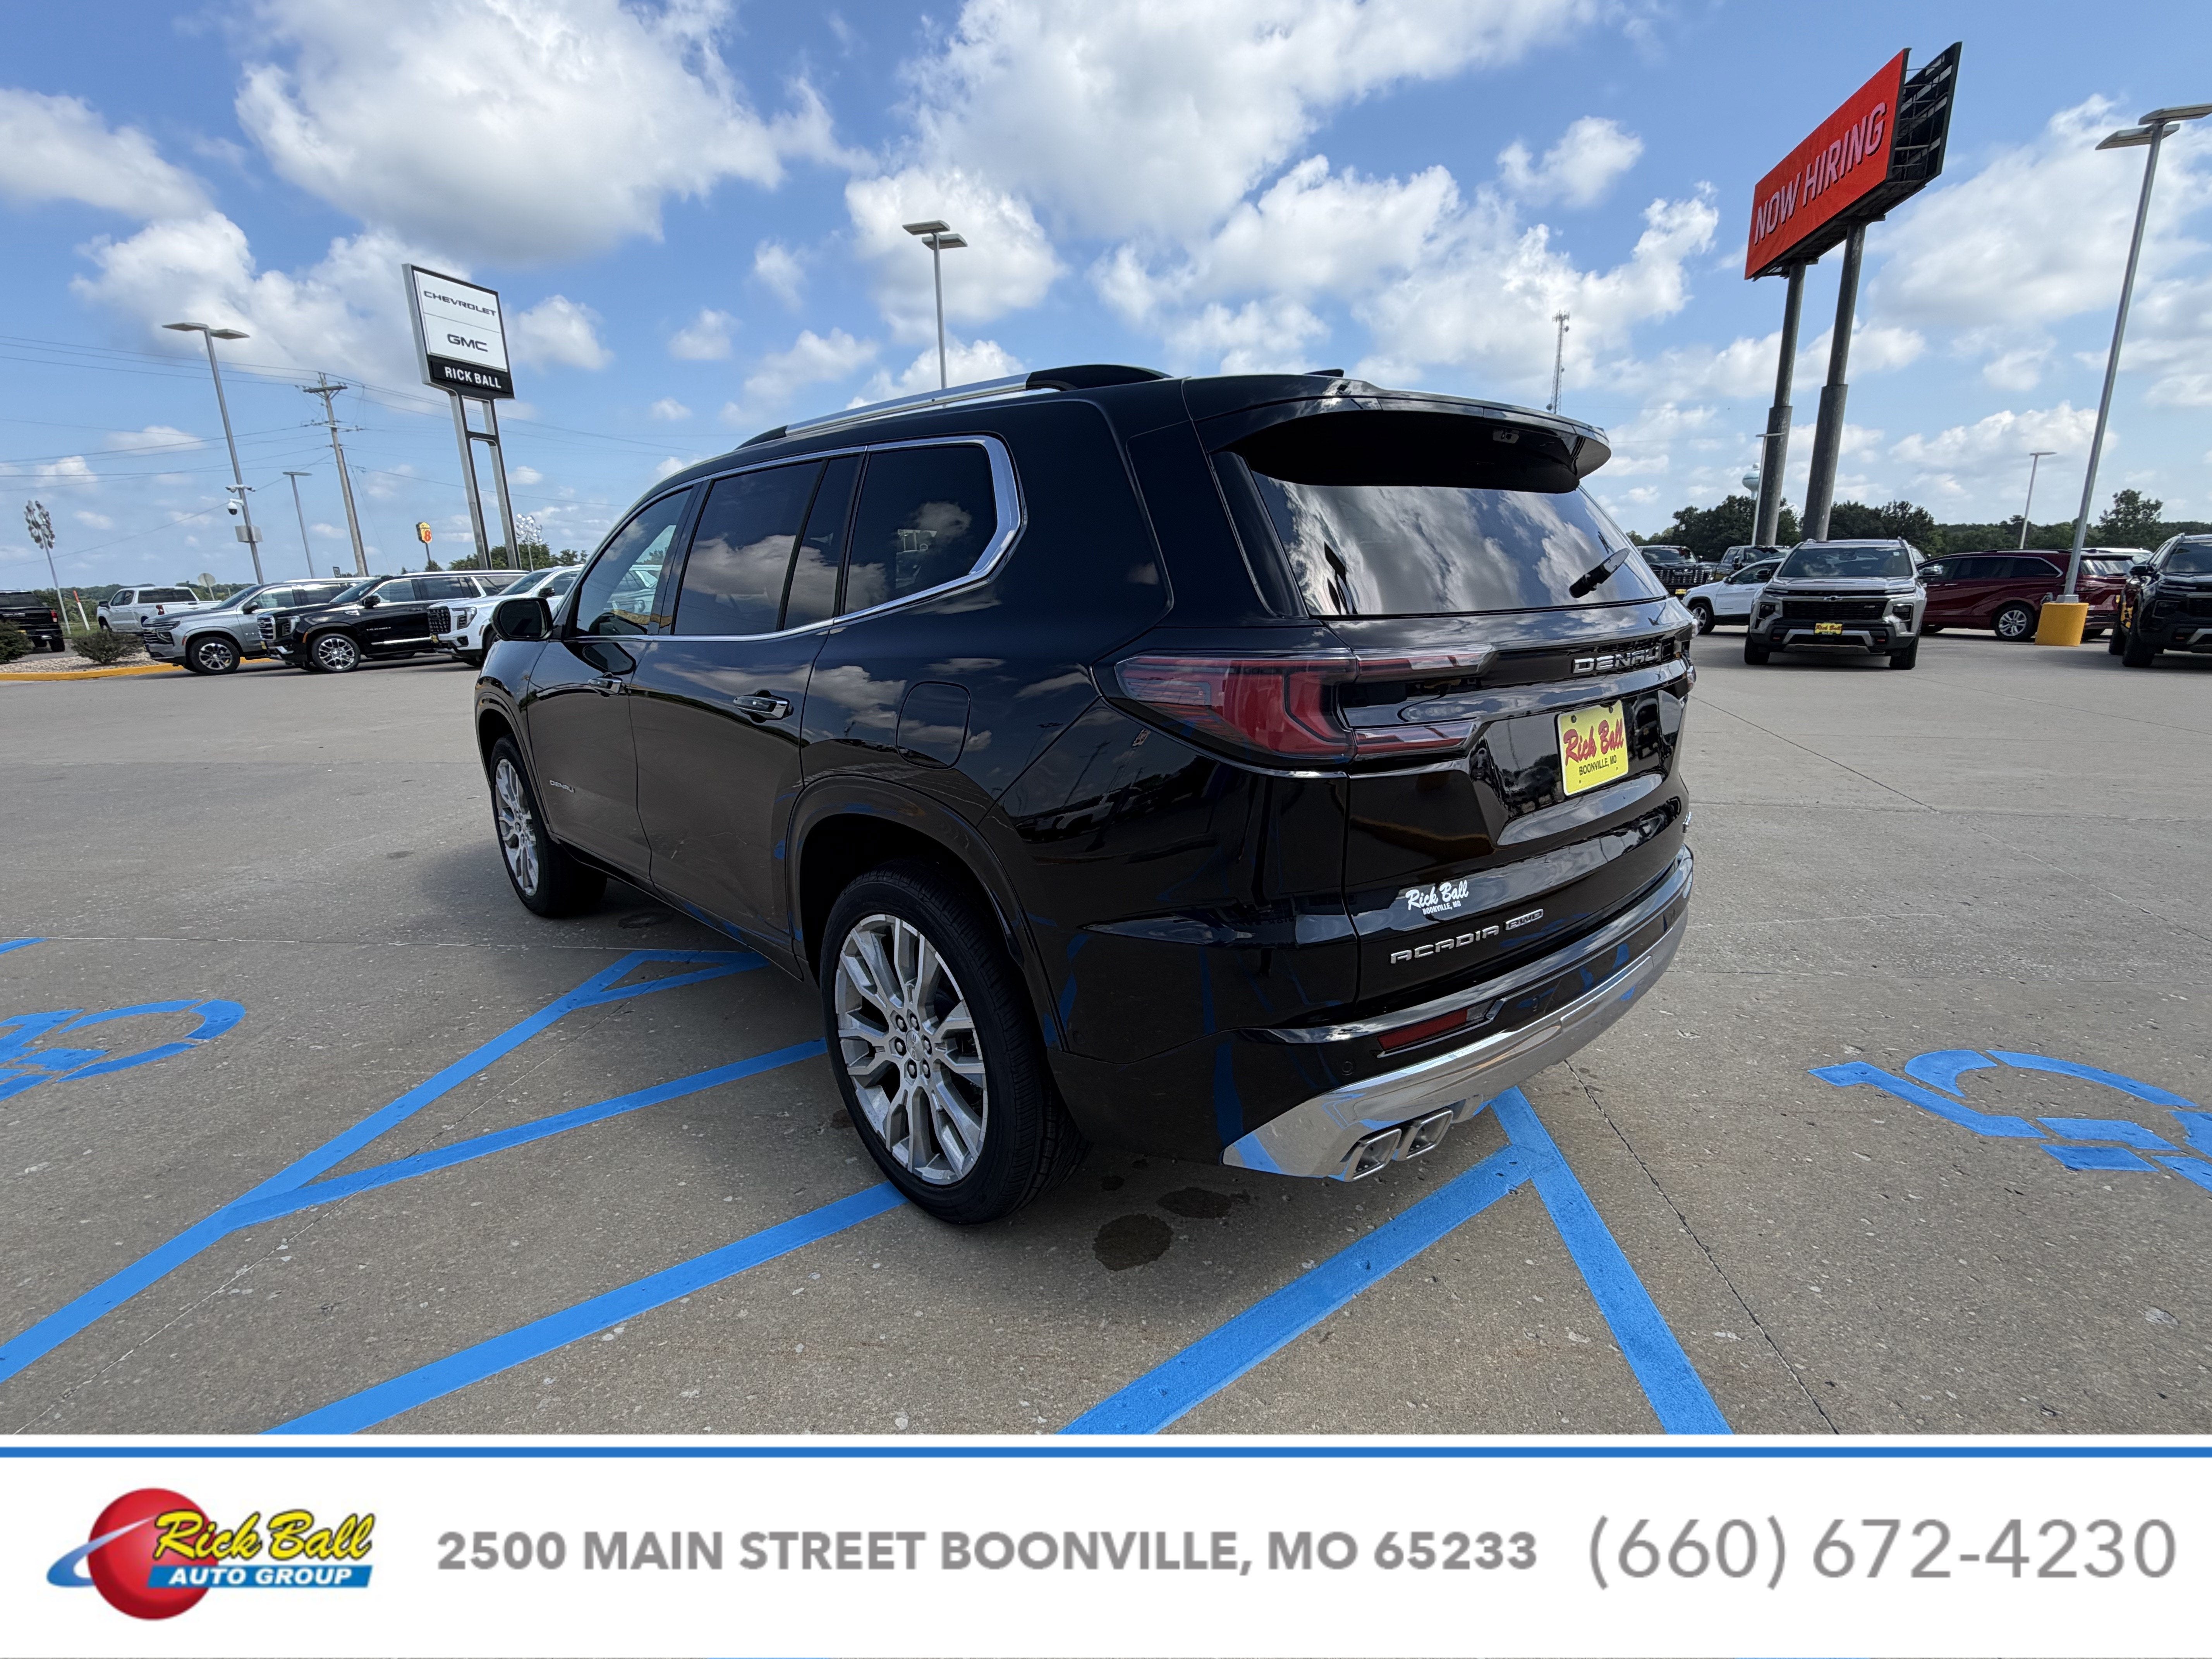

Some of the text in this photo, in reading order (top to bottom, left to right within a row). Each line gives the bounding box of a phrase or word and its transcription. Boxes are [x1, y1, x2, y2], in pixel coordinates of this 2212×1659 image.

[1754, 101, 1887, 246] NOW HIRING
[424, 290, 496, 316] CHEVROLET
[447, 333, 488, 352] GMC
[445, 366, 501, 388] RICK BALL
[424, 530, 431, 542] 8
[1573, 646, 1662, 674] DENALI
[1563, 718, 1624, 766] Rick Ball
[1578, 754, 1617, 776] BOONVILLE, MO
[1405, 880, 1469, 910] Rick Ball
[1422, 902, 1453, 915] BOONVILLE,
[1390, 910, 1543, 964] ACADIA AWD
